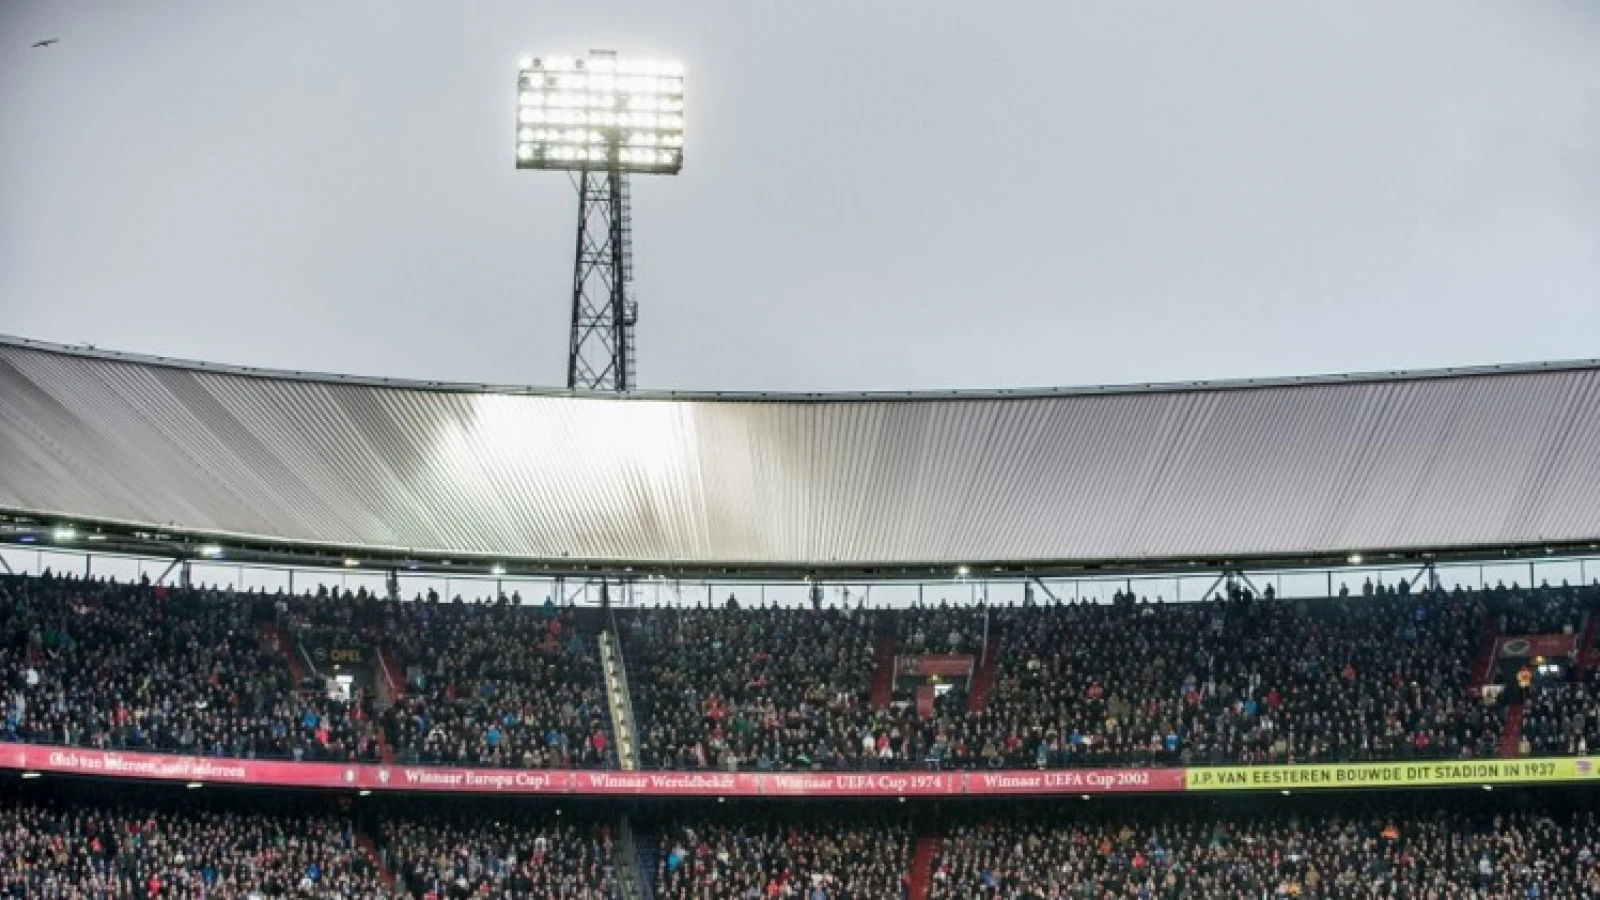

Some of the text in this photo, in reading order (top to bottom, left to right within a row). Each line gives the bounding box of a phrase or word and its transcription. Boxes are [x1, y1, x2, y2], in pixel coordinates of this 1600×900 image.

[405, 769, 462, 785] Winnaar
[466, 771, 513, 789] Europa
[516, 773, 542, 789] Cup
[590, 774, 735, 788] Winnaar Wereldbeker
[775, 774, 942, 791] Winnaar UEFA Cup 1974
[984, 772, 1148, 789] Winnaar UEFA Cup 2002
[1192, 763, 1555, 785] J.P. VAN EESTEREN BOUWDE DIT STADION IN 1937
